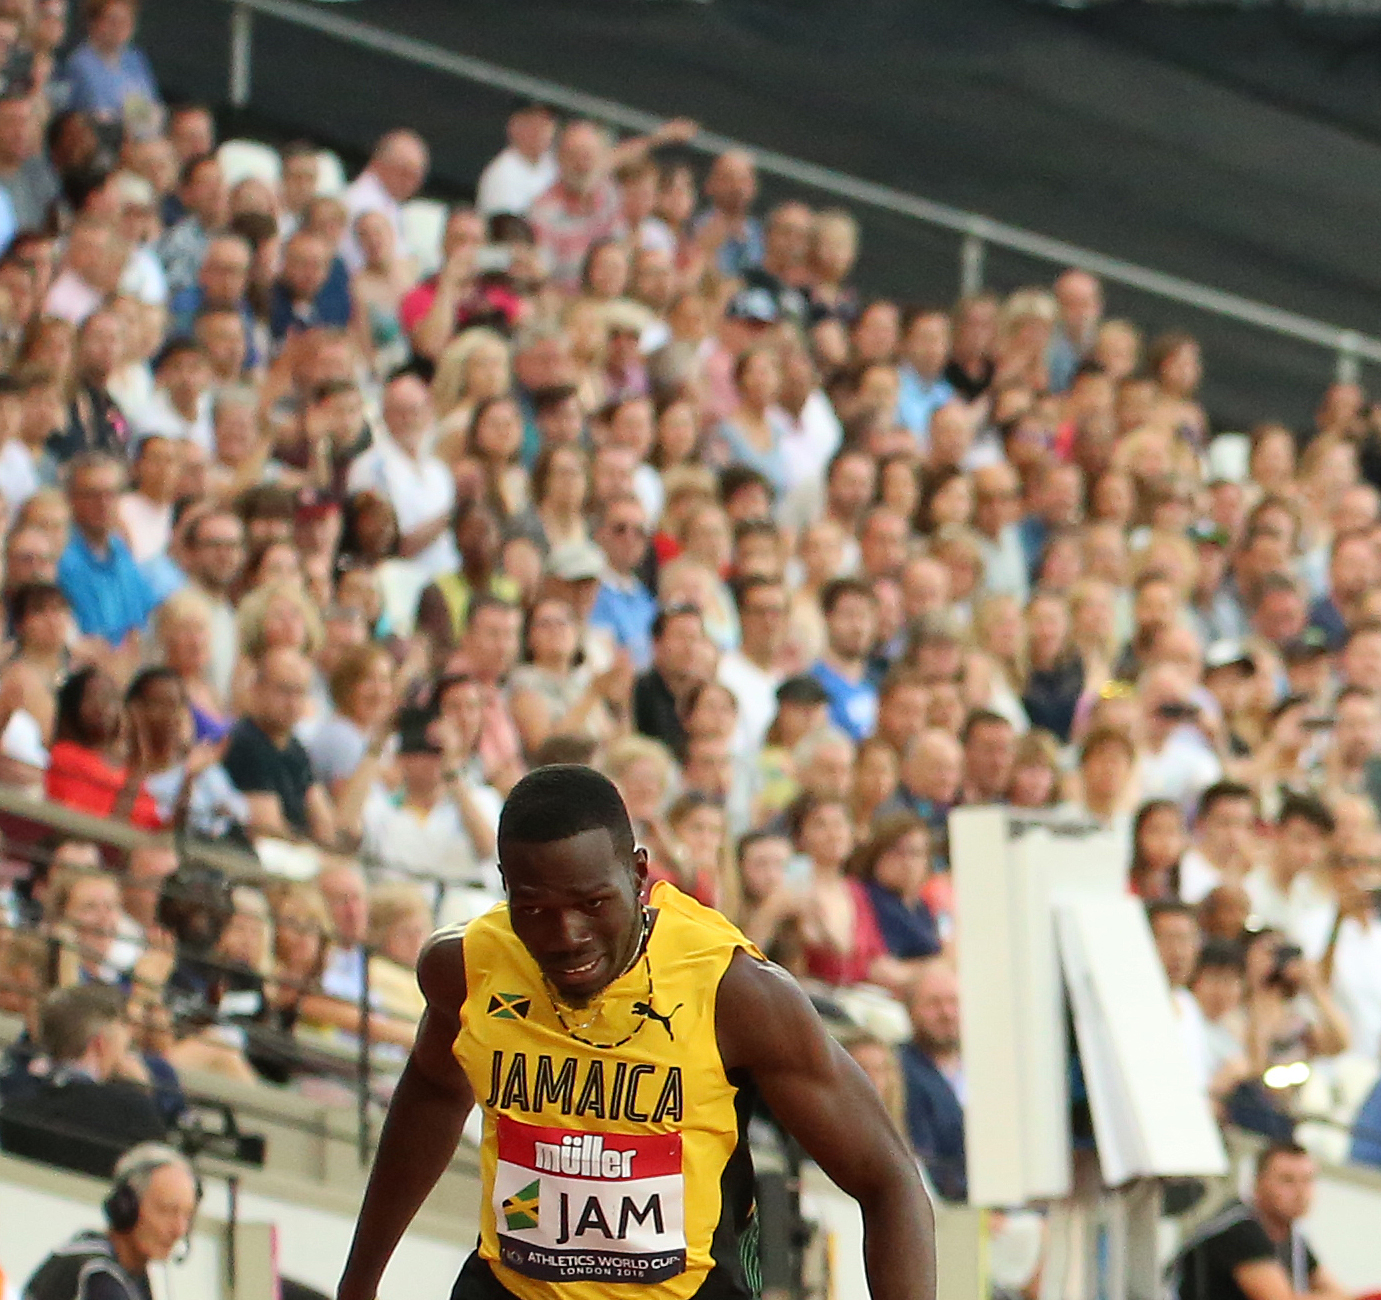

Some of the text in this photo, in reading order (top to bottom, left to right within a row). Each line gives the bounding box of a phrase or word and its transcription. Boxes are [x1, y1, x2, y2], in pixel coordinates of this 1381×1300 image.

[485, 1050, 685, 1124] JAMAICA
[534, 1134, 637, 1178] müller
[555, 1191, 665, 1245] JAM
[527, 1251, 595, 1267] ATHLETICS
[599, 1255, 649, 1270] WORLD
[560, 1267, 645, 1278] LONDON 2018
